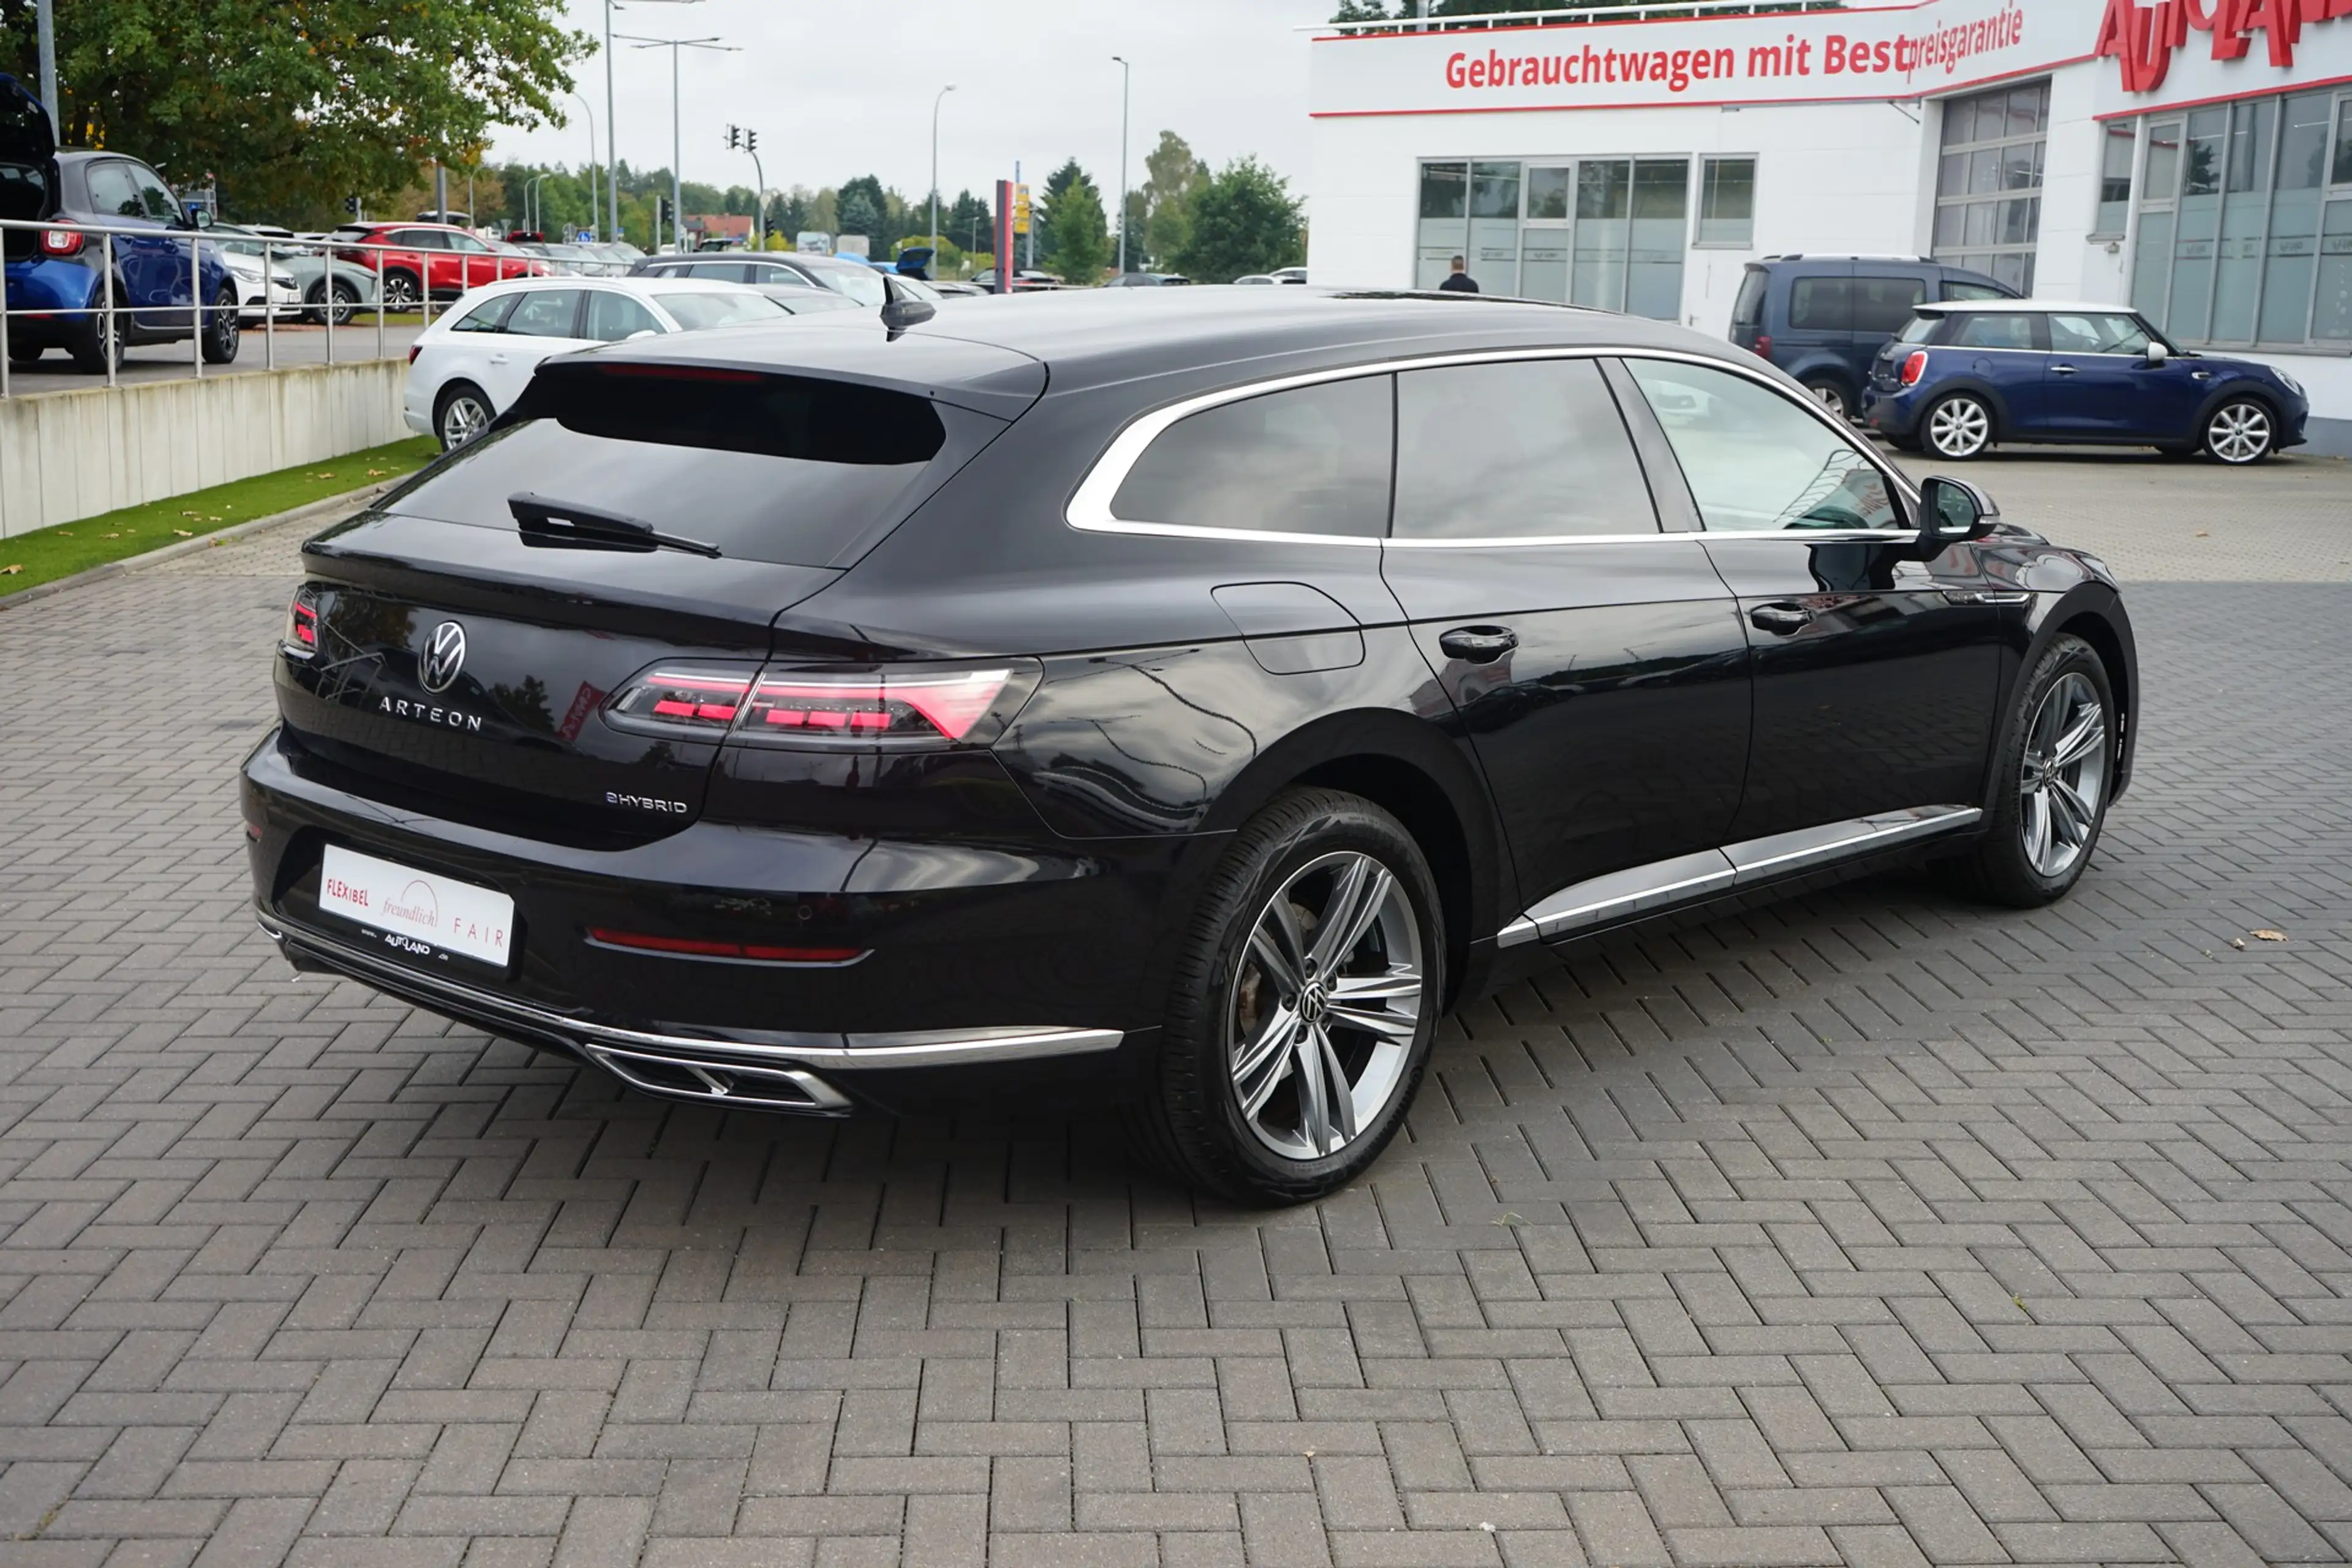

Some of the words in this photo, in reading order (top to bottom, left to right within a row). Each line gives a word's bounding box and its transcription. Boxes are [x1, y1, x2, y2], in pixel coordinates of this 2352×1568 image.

[1446, 45, 1735, 92] Gebrauchtwagen
[1747, 34, 1811, 77] mit
[1823, 0, 2023, 84] Bestpreisgarantie
[2093, 0, 2352, 92] AUTLAN
[379, 696, 481, 731] ARTEON
[326, 878, 369, 907] FLEXIBEL
[380, 897, 435, 927] freundlich
[453, 918, 503, 948] FAIR
[385, 933, 431, 955] AUTOLAND
